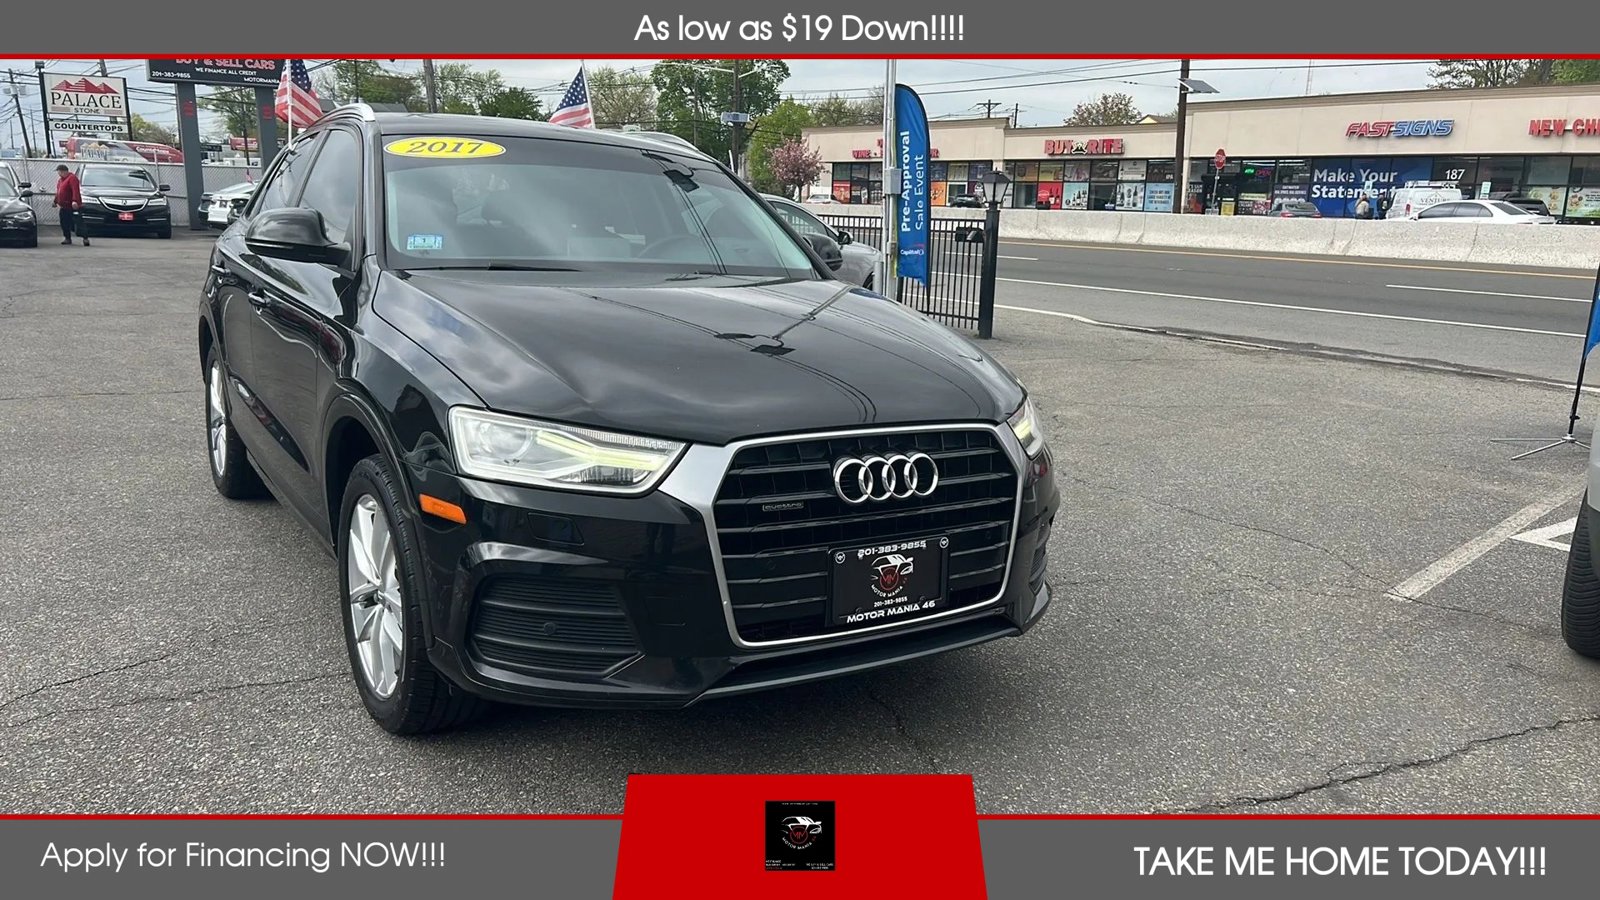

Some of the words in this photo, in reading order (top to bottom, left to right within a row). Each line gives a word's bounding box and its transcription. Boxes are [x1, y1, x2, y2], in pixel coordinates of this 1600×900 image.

[244, 59, 275, 70] CARS
[152, 71, 191, 79] 201-383-9855
[50, 92, 122, 109] PALACE
[54, 123, 123, 132] COUNTERTOPS
[1345, 120, 1454, 137] FASTSIGNS
[1529, 119, 1567, 137] NEW
[406, 141, 482, 154] 2017
[1044, 139, 1073, 155] BUY
[1087, 138, 1124, 155] RITE
[900, 130, 912, 232] Pre-Approval
[914, 154, 924, 196] Event
[1313, 168, 1355, 182] Make
[1359, 168, 1398, 182] Your
[1445, 169, 1465, 180] 187
[1311, 184, 1396, 199] Statement
[914, 201, 924, 230] Sale
[857, 540, 927, 557] 201-383-9855
[871, 584, 887, 598] MOTOR
[887, 585, 903, 597] MANIA
[873, 596, 908, 607] 201-383-9855
[846, 610, 885, 623] MOTOR
[887, 603, 920, 616] MANIA
[922, 600, 936, 609] 46
